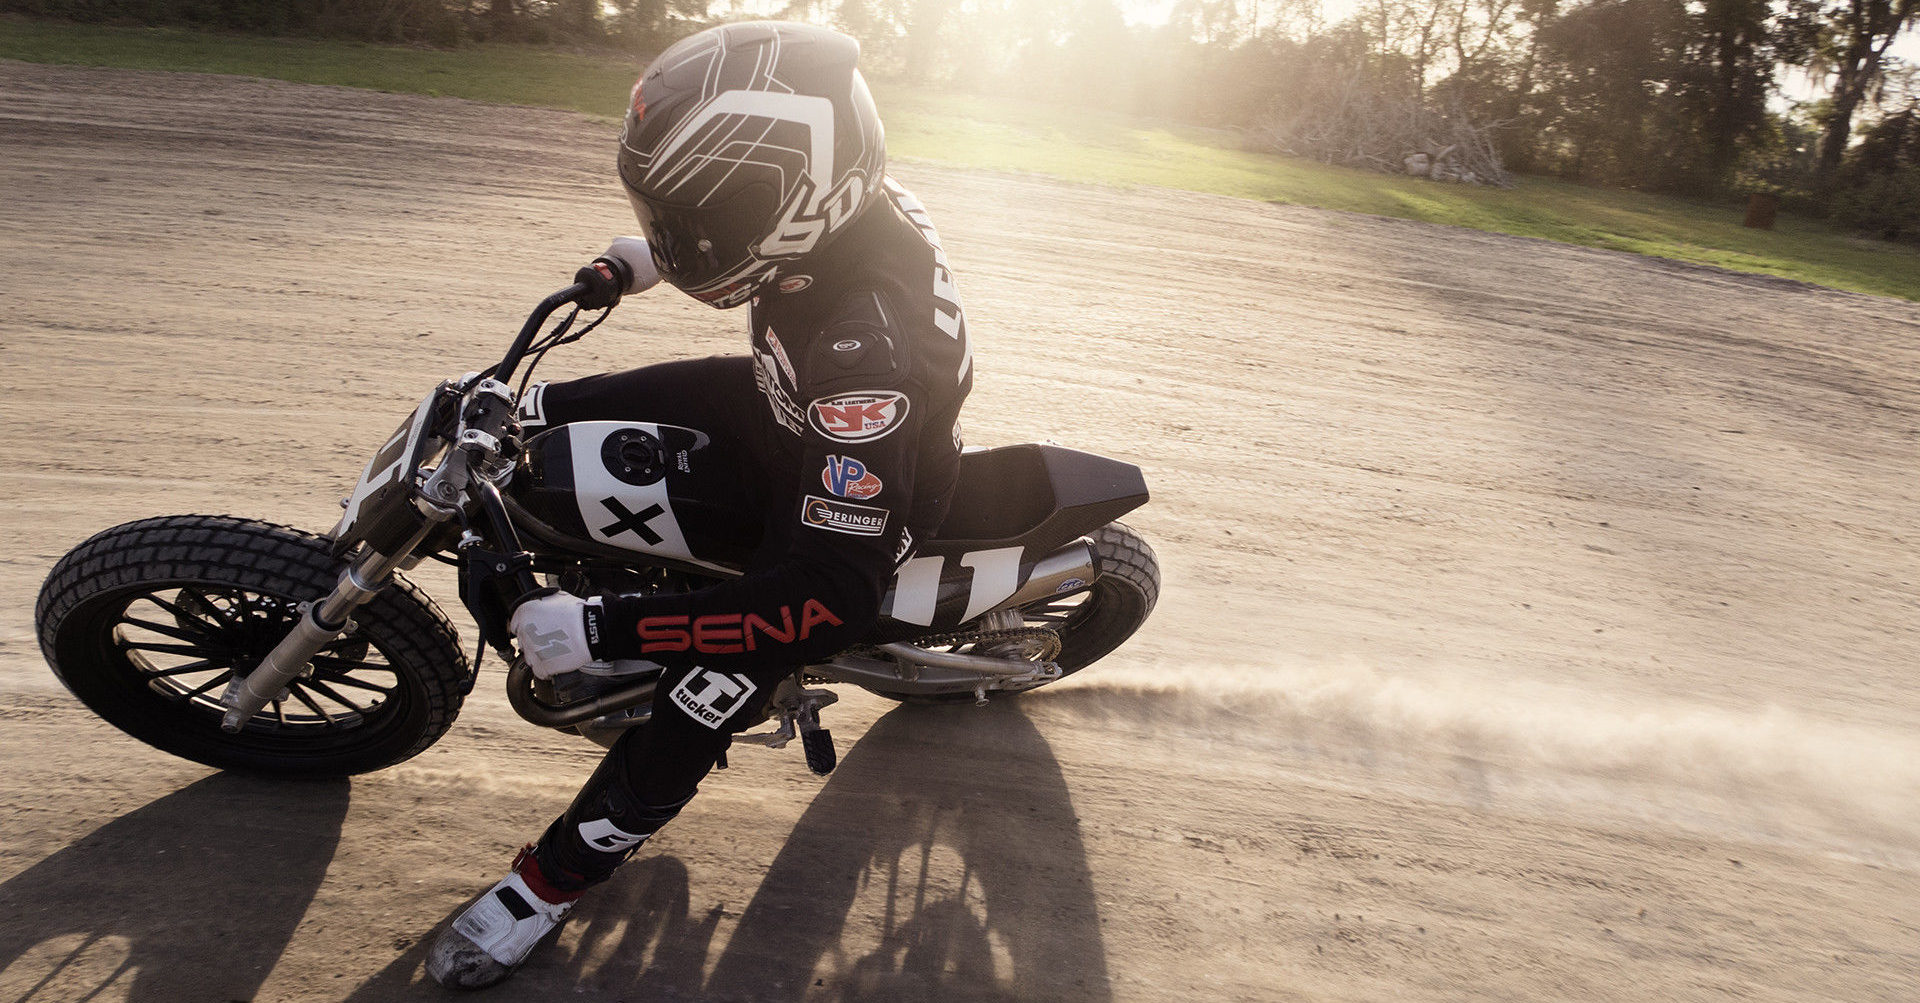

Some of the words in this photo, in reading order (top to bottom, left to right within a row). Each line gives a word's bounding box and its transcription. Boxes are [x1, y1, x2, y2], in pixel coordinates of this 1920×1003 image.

[864, 420, 886, 431] USA
[827, 455, 866, 497] VP
[847, 481, 878, 494] Racing
[636, 598, 844, 654] SENA
[675, 688, 723, 725] tucker
